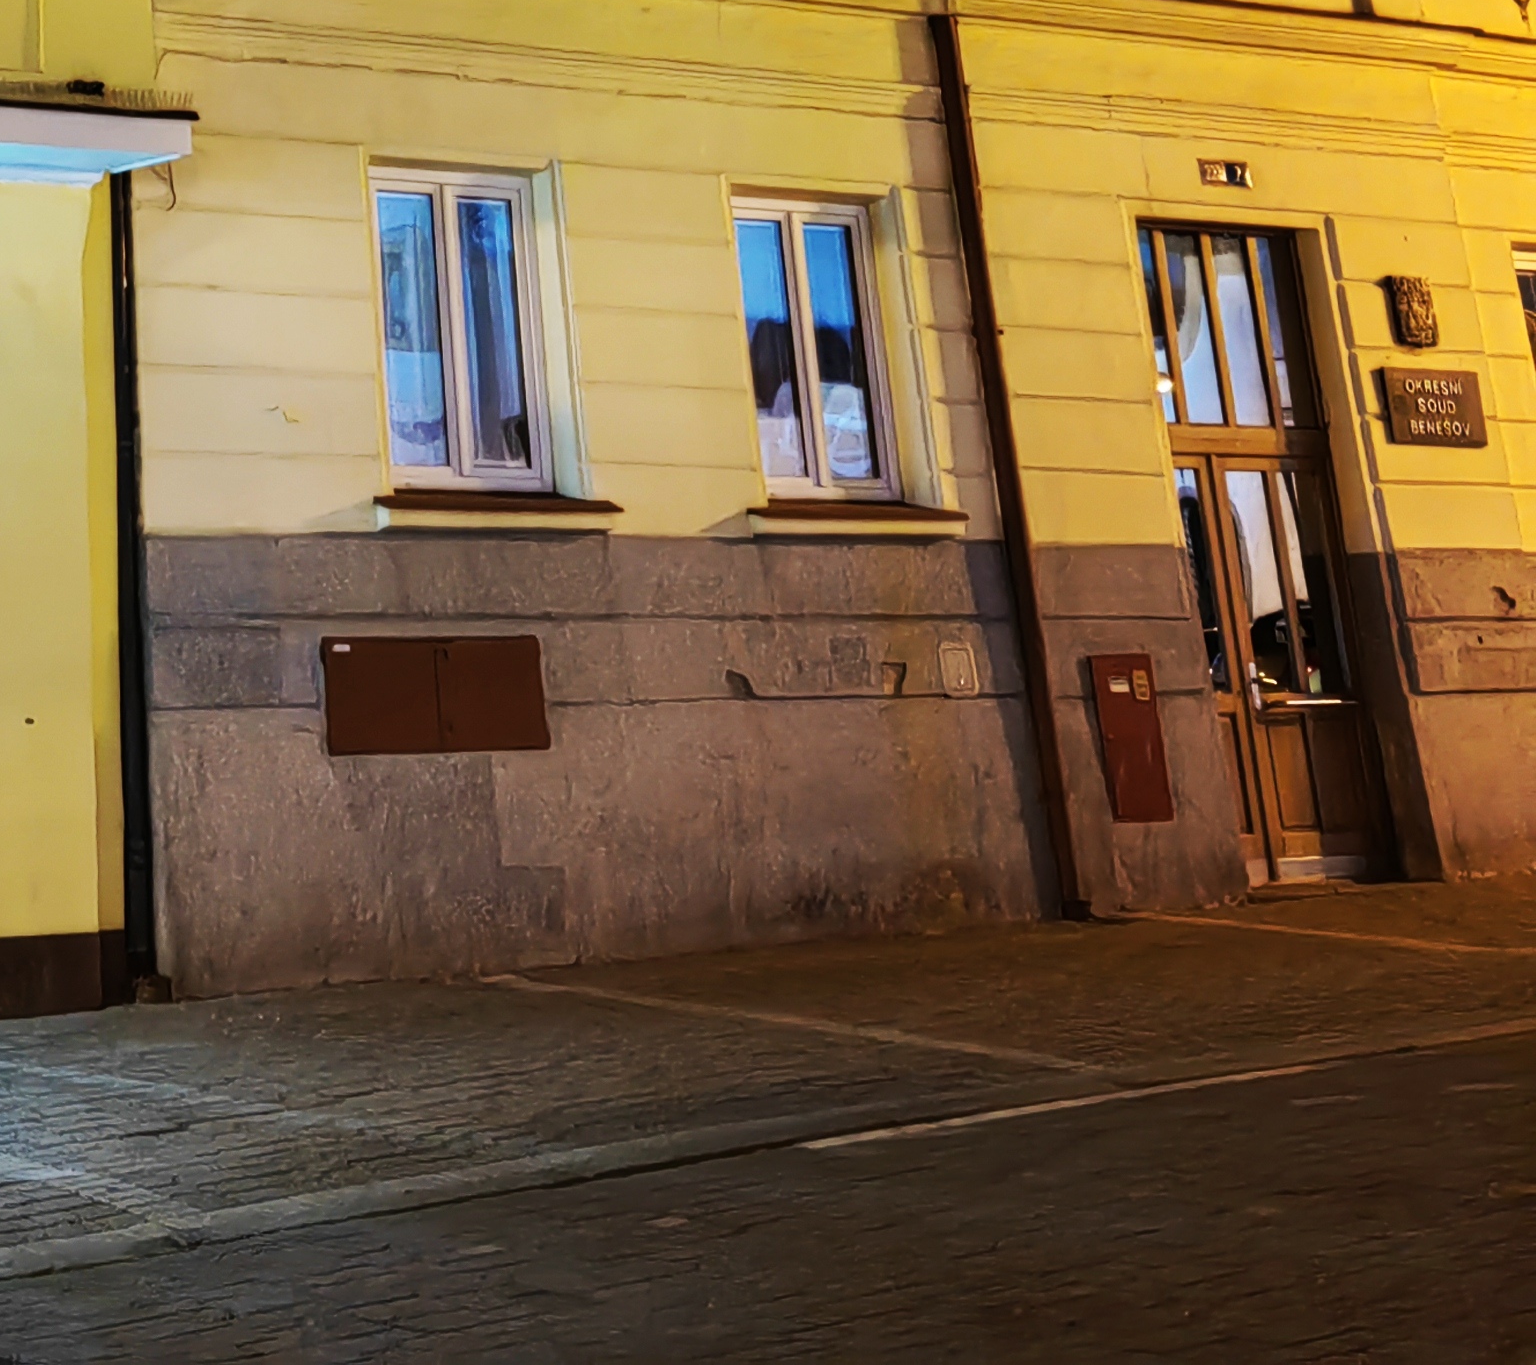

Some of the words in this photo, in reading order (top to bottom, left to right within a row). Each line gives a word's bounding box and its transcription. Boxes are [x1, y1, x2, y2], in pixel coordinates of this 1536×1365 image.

[1405, 378, 1463, 396] OKRESNÍ
[1418, 397, 1456, 415] SOUD
[1410, 418, 1470, 437] BENEŠOV
